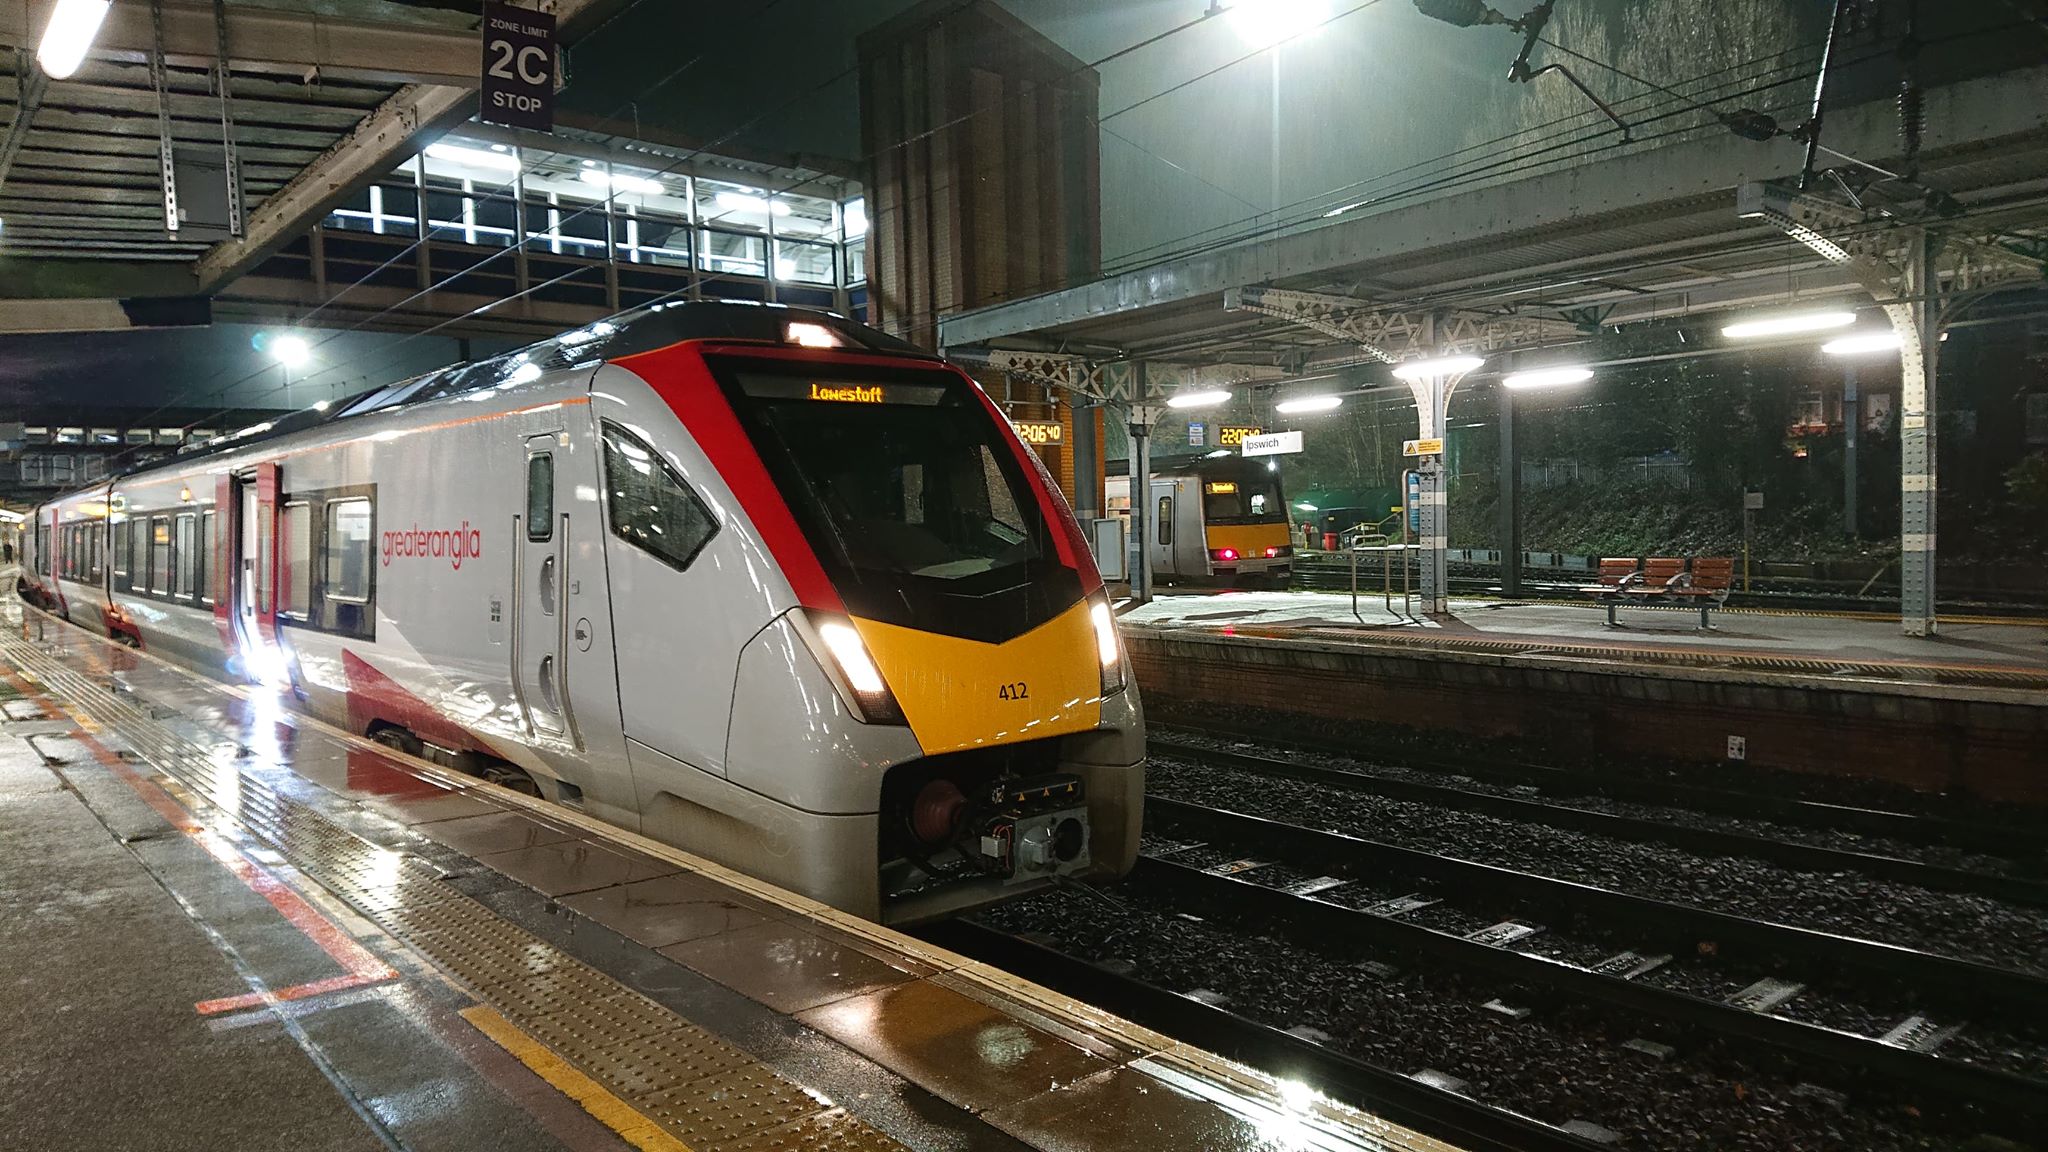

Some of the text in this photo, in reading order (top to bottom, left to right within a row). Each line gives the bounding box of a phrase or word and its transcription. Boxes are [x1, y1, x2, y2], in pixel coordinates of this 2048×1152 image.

[490, 18, 549, 38] ZONE LIMIT
[488, 39, 548, 85] 2C
[493, 91, 542, 113] STOP
[812, 383, 882, 403] Lowestoft
[1246, 437, 1279, 451] Ipswich
[382, 520, 480, 570] greateranglia
[999, 681, 1029, 701] 412
